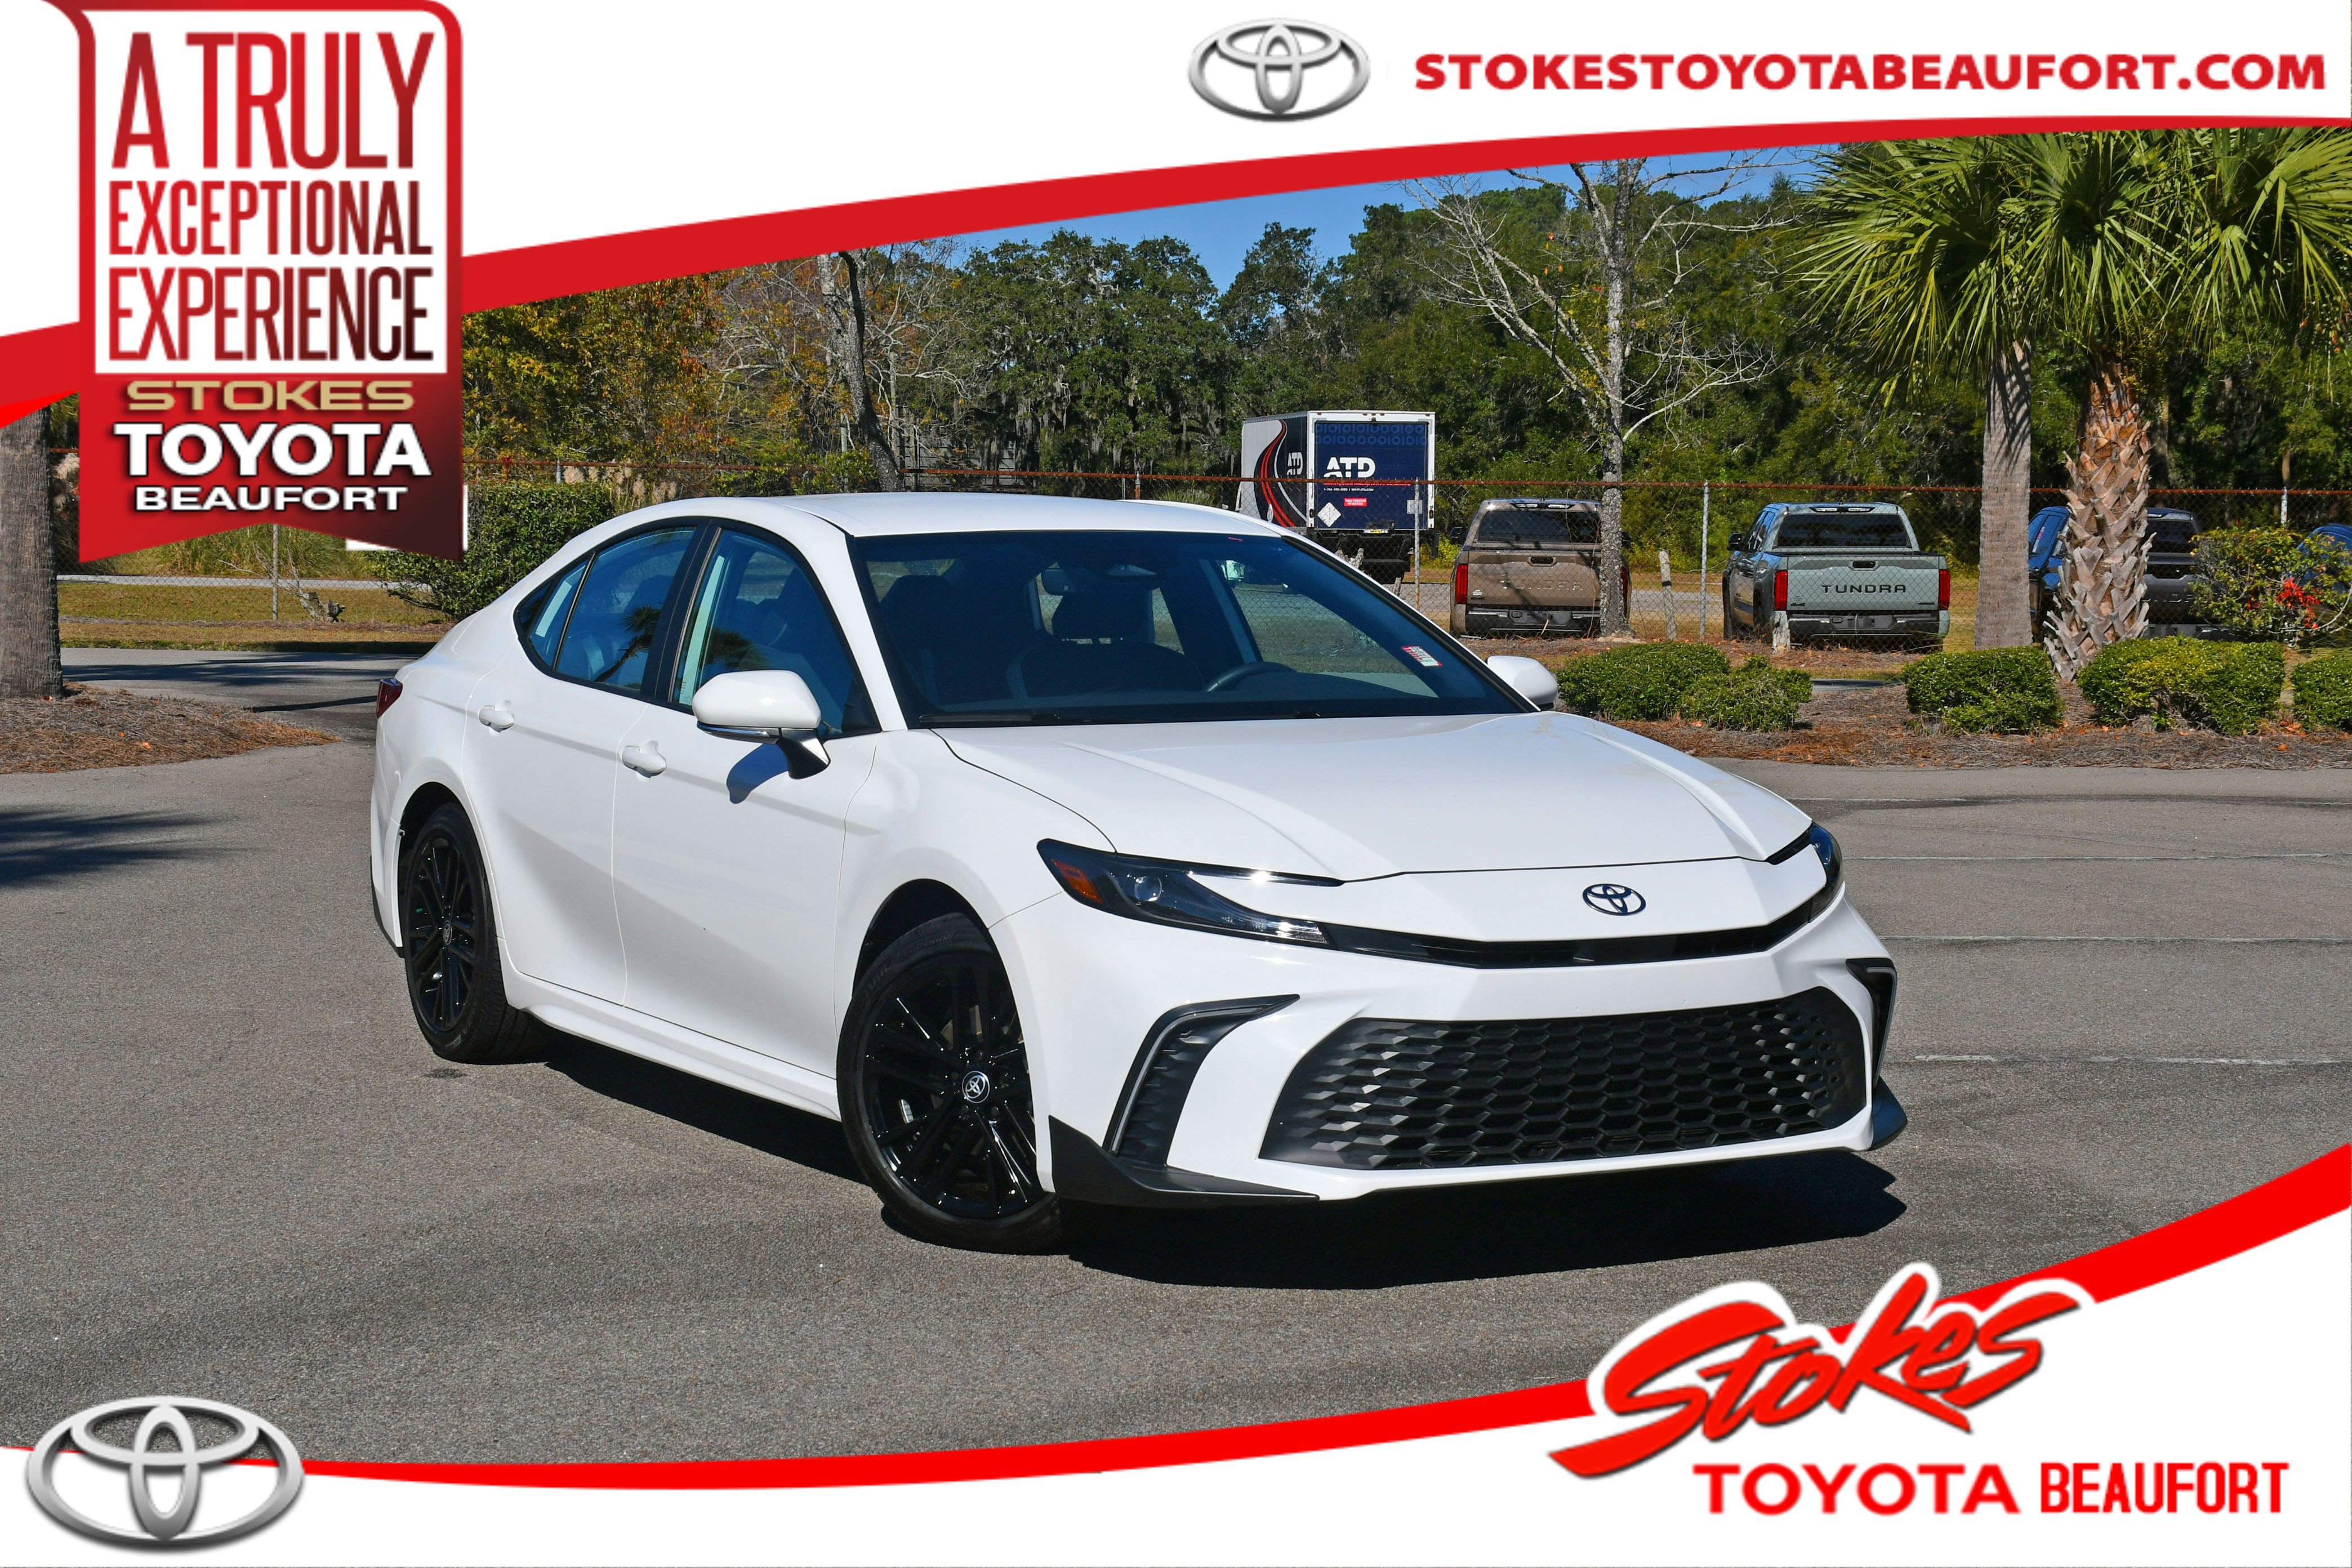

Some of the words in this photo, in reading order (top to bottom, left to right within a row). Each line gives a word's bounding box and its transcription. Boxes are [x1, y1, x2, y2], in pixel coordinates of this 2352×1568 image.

[1286, 452, 1303, 475] ATD
[1324, 457, 1376, 478] ATD
[1821, 584, 1906, 593] TUNDRA
